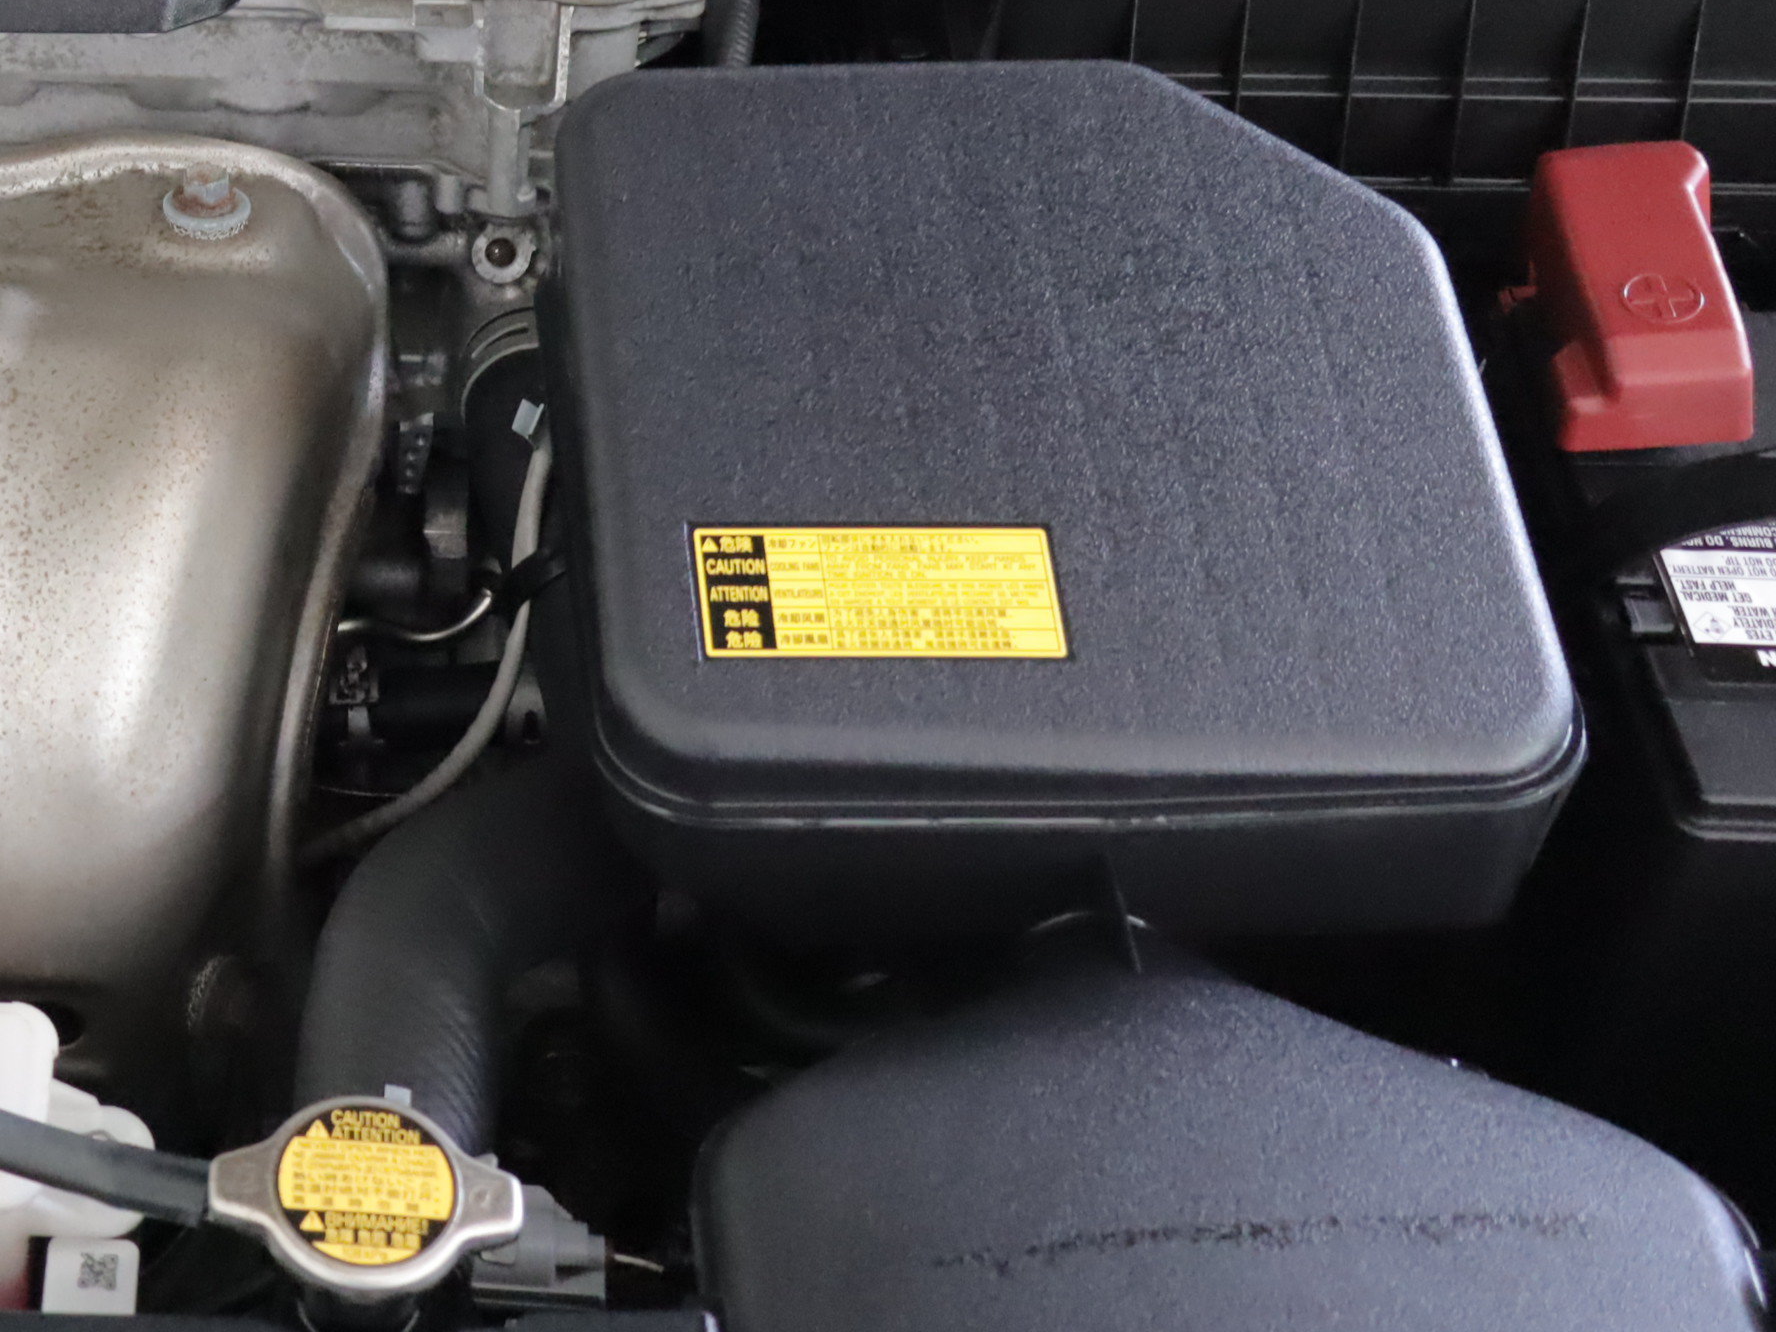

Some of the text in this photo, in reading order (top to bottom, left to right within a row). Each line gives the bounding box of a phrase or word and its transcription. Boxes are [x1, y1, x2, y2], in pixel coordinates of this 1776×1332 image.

[1705, 535, 1724, 546] DO
[1725, 536, 1773, 548] BURNS.
[705, 557, 766, 576] CAUTION
[1743, 557, 1763, 567] NOT
[1668, 564, 1714, 575] BATTERY.
[1717, 566, 1744, 576] OPEN
[1747, 567, 1767, 577] NOT
[1676, 579, 1736, 590] HELP FAST.
[709, 585, 769, 602] ATTENTION
[1680, 590, 1752, 603] GET MEDICAL
[1727, 606, 1770, 617] WATER.
[1745, 629, 1773, 641] EYES
[330, 1109, 401, 1129] CAUTION
[331, 1126, 422, 1145] ATTENTION
